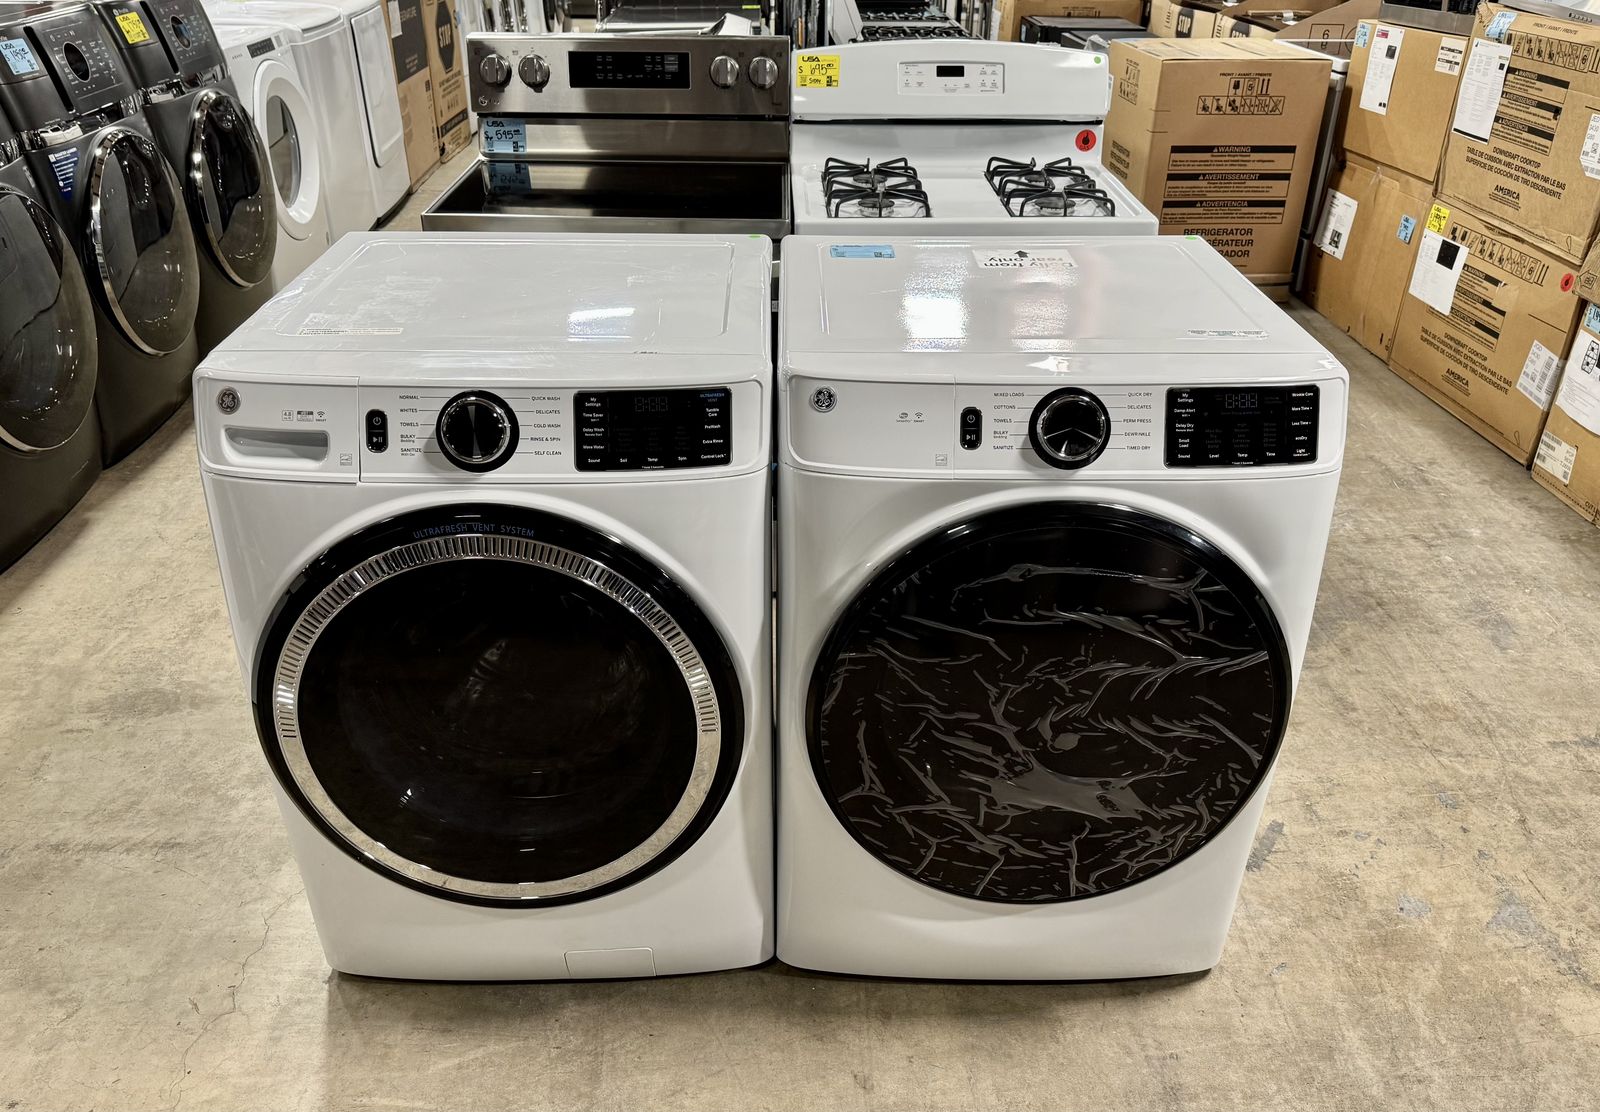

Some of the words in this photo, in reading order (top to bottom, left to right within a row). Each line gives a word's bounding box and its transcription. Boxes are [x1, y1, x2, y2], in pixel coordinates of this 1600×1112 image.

[1178, 15, 1191, 34] STOP
[438, 23, 451, 48] STOP
[1518, 69, 1538, 80] WARNING
[495, 130, 514, 140] 595
[1493, 146, 1520, 161] DOWNDRAFT
[1519, 156, 1542, 169] COOKTOP
[1466, 155, 1488, 170] SUPERFICIE
[1487, 164, 1494, 173] DE
[1513, 174, 1520, 183] DE
[1520, 176, 1531, 187] TIRO
[1530, 180, 1562, 200] DESCENDENTE
[1467, 146, 1479, 157] TABLE
[1478, 151, 1484, 159] DE
[1484, 153, 1503, 166] CUISSON
[1503, 159, 1514, 170] AVEC
[1514, 164, 1541, 180] EXTRACTION
[1540, 174, 1550, 184] PAR
[1549, 178, 1556, 187] LE
[1555, 180, 1567, 191] BAS
[1494, 184, 1520, 201] AMERICA
[1183, 227, 1254, 236] REFRIGERATOR
[1467, 347, 1488, 362] COOKTOP
[1445, 368, 1469, 388] AMERICA
[1463, 352, 1488, 372] EXTRACTION
[1487, 368, 1497, 377] PAR
[1496, 373, 1503, 382] LE
[1502, 377, 1513, 388] BAS
[1478, 369, 1509, 396] DESCENDENTE
[413, 524, 468, 539] ULTRAFRESH
[472, 524, 496, 532] VENT
[500, 525, 535, 537] SYSTEM
